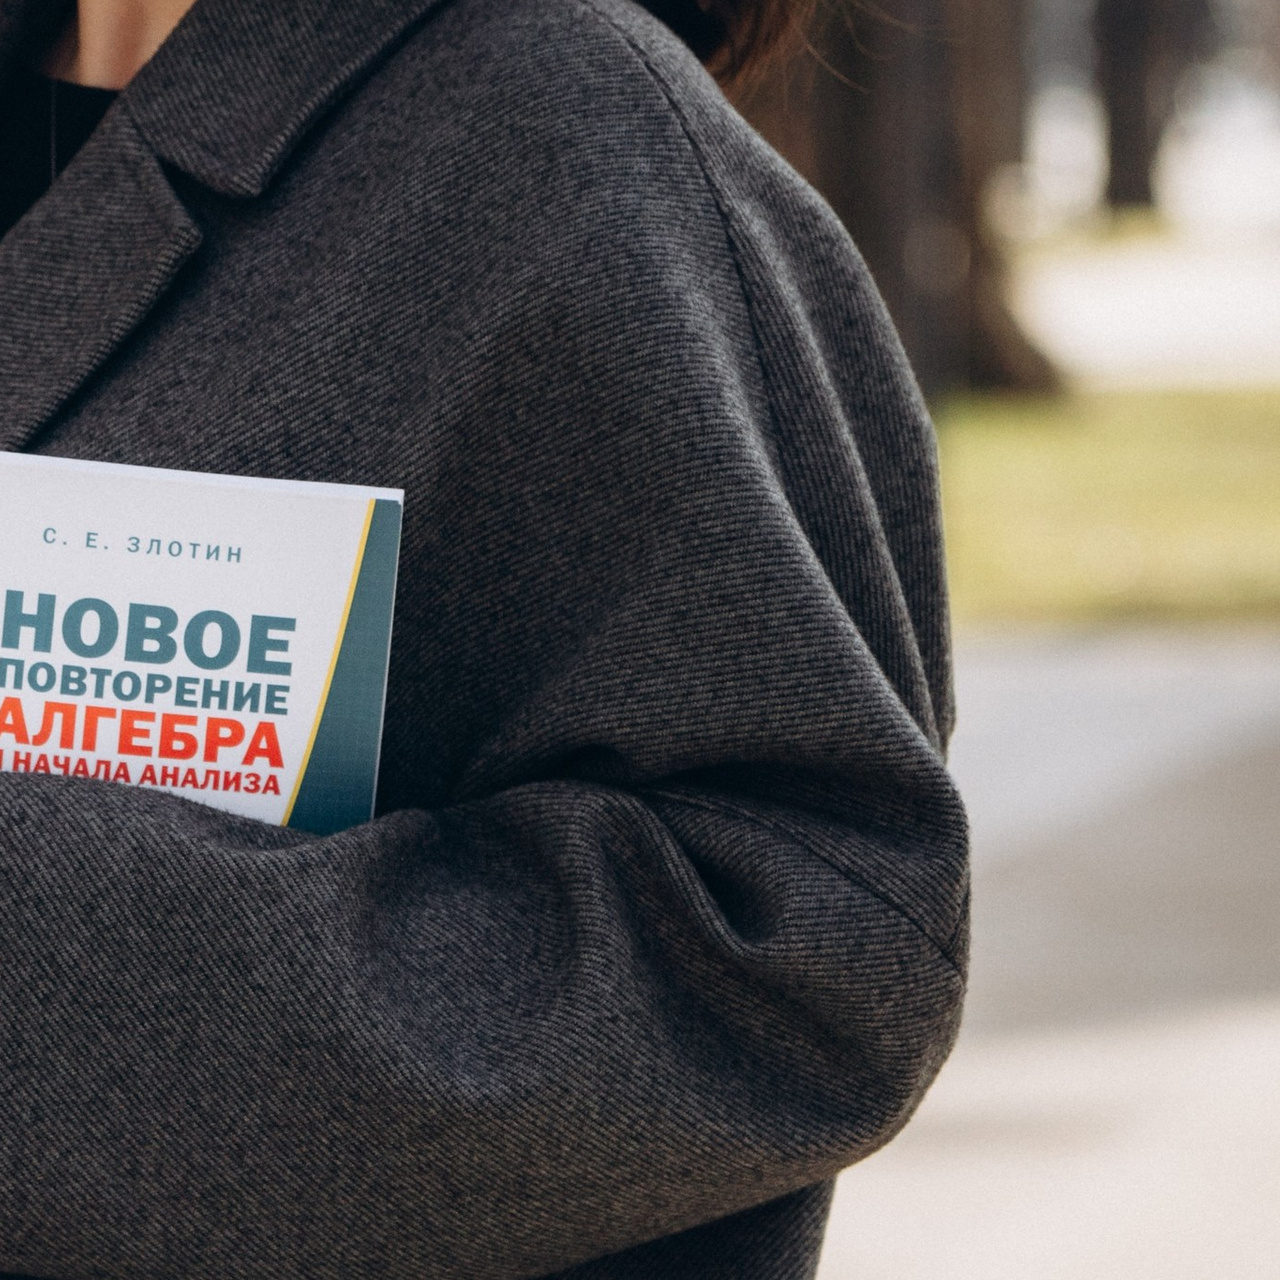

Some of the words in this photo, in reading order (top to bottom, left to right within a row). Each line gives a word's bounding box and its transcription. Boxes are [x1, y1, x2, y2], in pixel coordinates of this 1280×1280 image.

[43, 527, 68, 546] С.
[86, 532, 109, 550] Е.
[127, 536, 242, 563] ЗЛОТИН
[1, 589, 296, 676] НОВОЕ
[12, 750, 131, 784] НАЧАЛА
[138, 764, 281, 796] АНАЛИЗА
